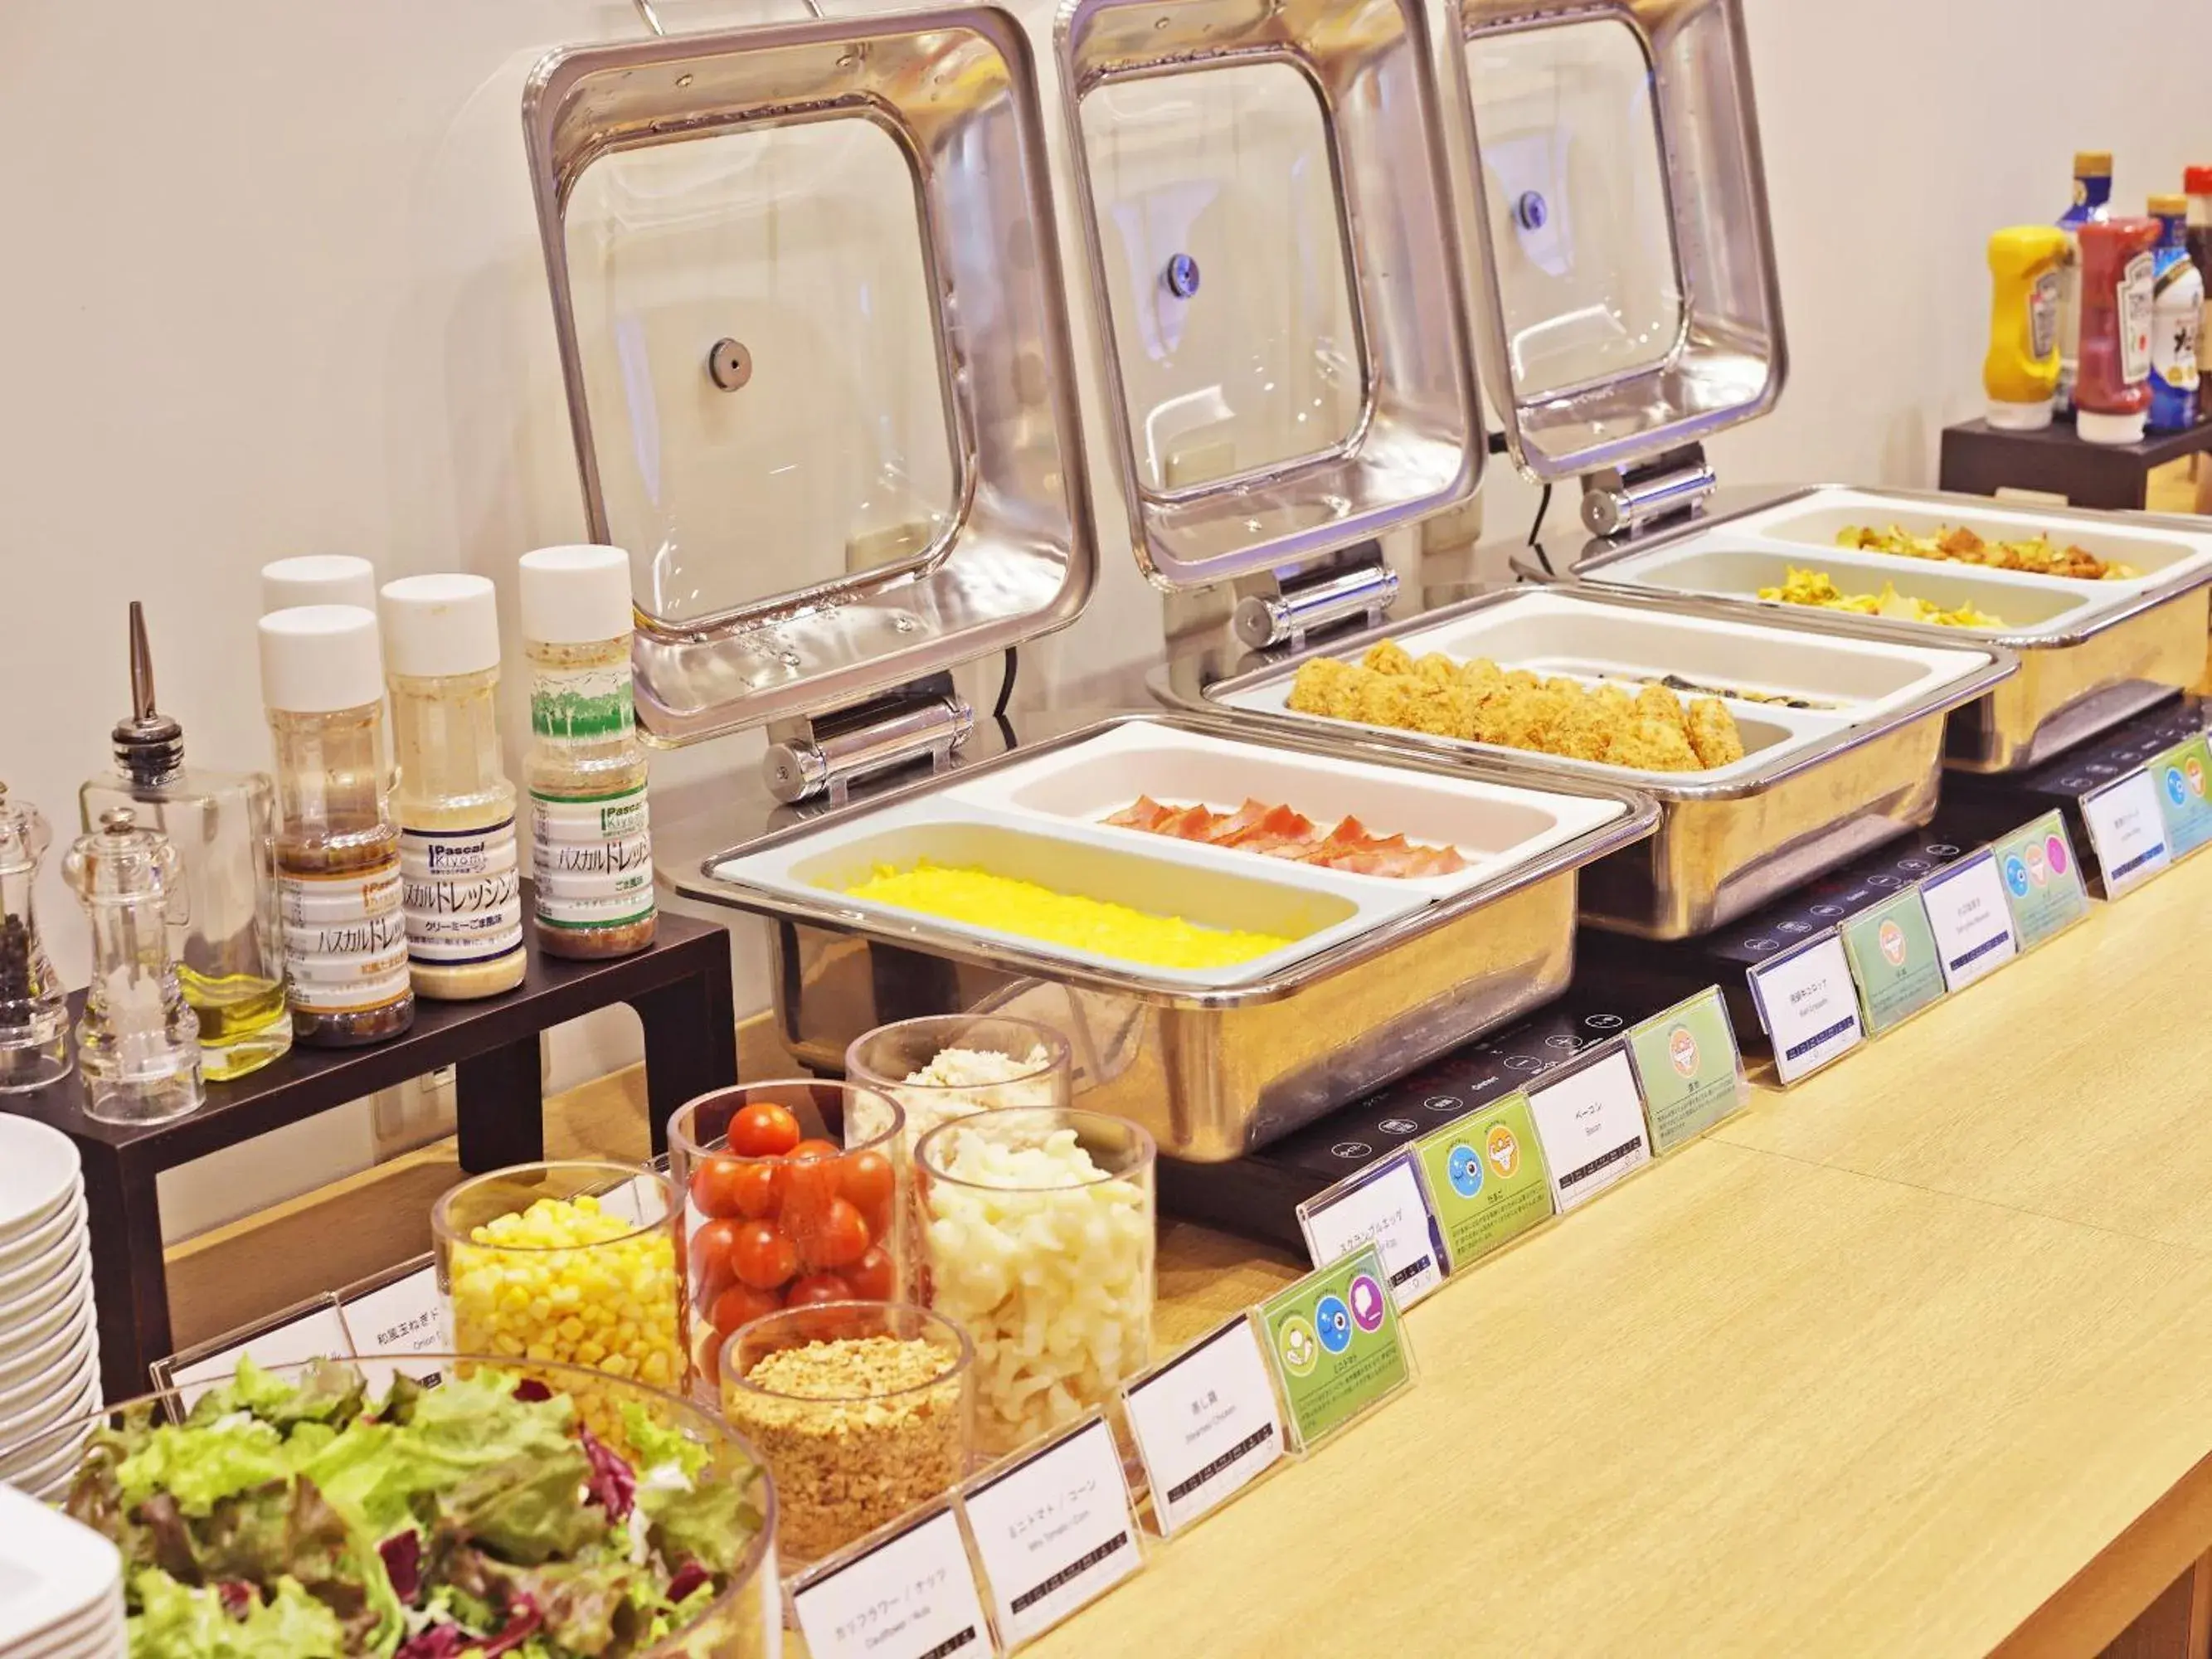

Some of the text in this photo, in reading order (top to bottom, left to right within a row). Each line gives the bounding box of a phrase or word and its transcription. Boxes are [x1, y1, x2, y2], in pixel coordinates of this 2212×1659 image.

[435, 842, 484, 855] Pascal
[403, 868, 520, 913] スカルドレッシング
[425, 913, 503, 932] クリーミーごま風味
[1576, 1102, 1602, 1120] ベーコン
[1339, 1208, 1403, 1254] スクランブルエッグ
[1009, 1503, 1054, 1540] ミニトマト
[1067, 1479, 1096, 1502] コーン
[834, 1597, 900, 1642] カリフラワー
[915, 1567, 946, 1594] ナッツ
